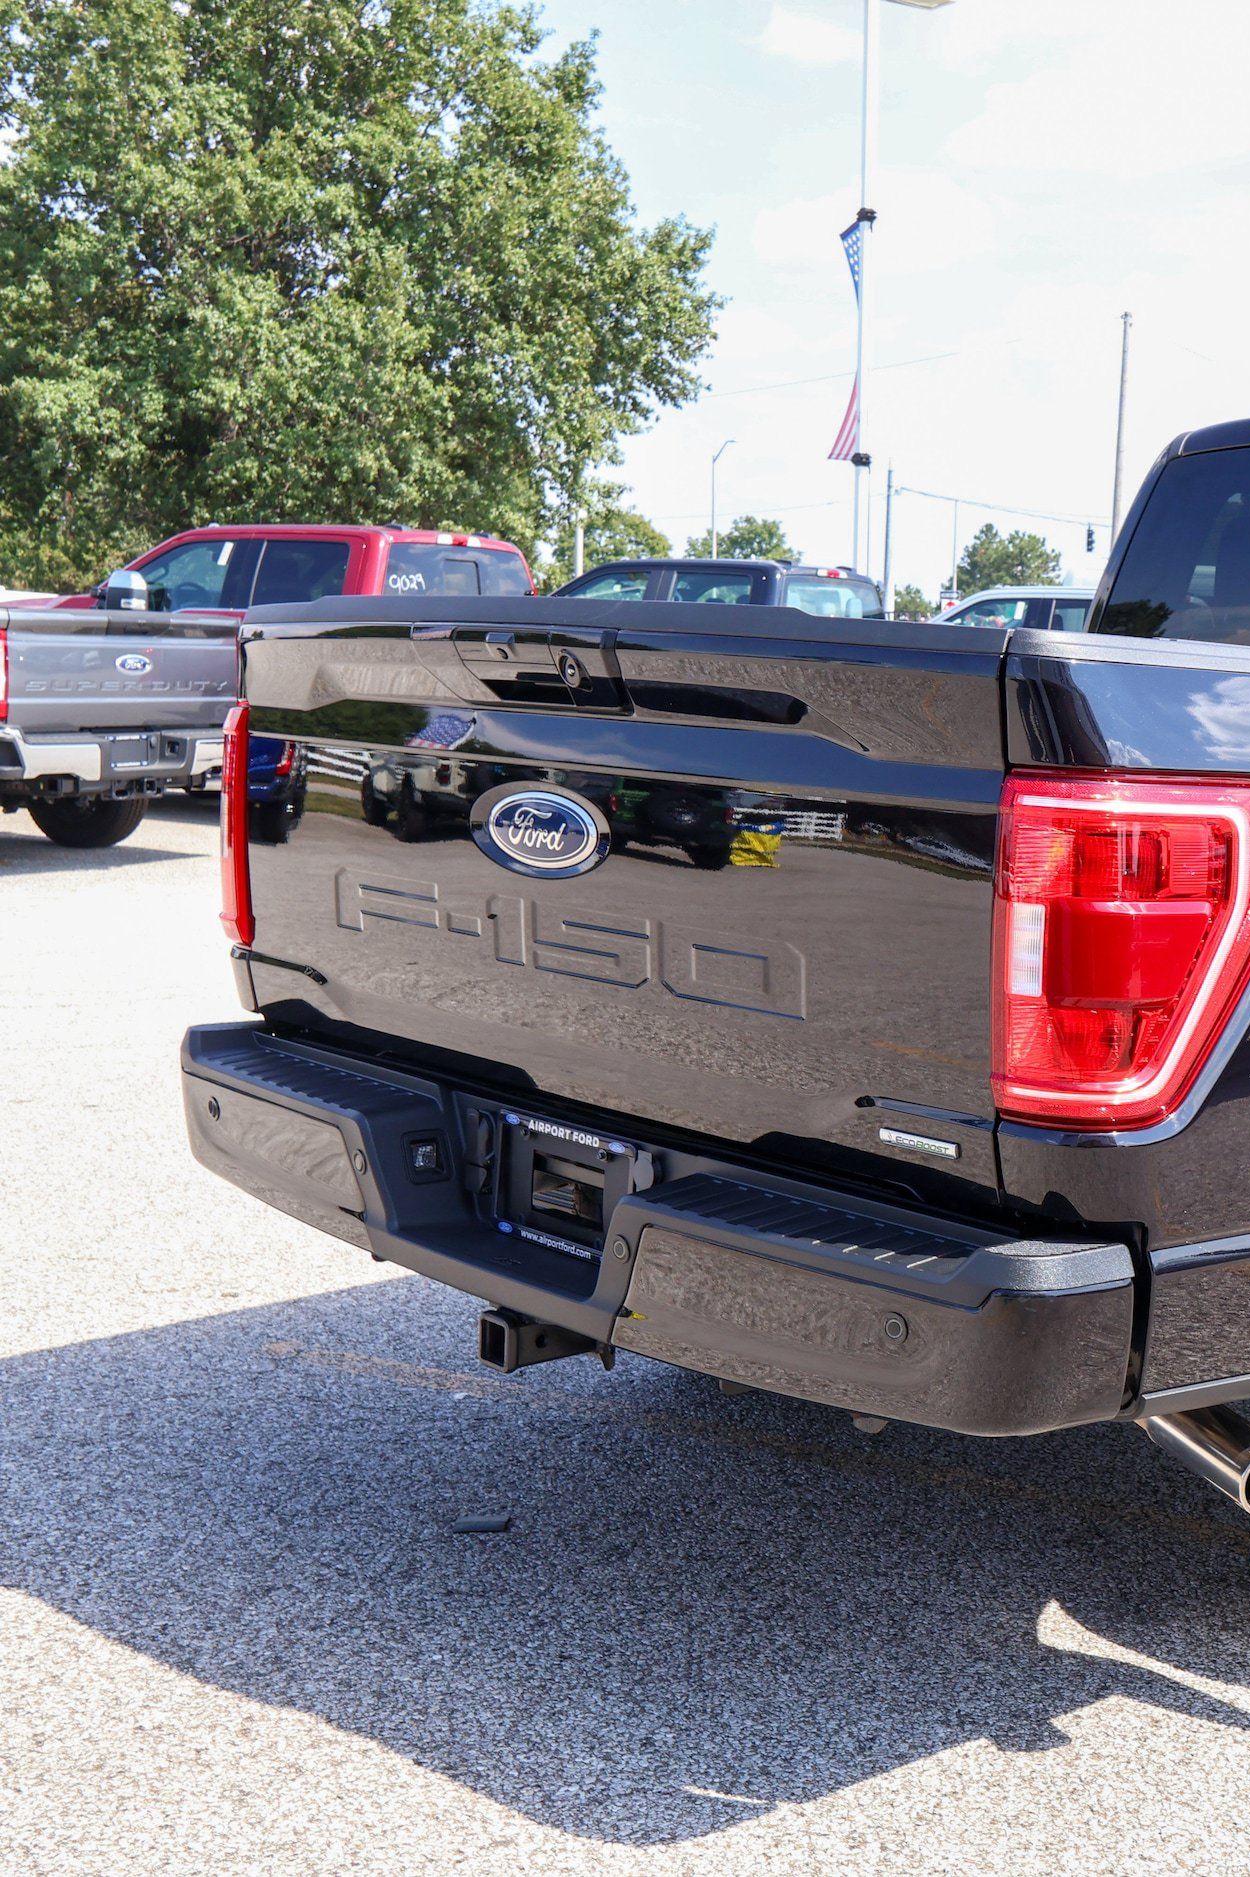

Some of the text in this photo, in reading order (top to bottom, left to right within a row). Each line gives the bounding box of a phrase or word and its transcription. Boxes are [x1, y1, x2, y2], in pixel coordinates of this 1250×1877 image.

[25, 680, 229, 692] SUPER DUTY
[508, 807, 566, 851] Ford
[334, 867, 806, 1021] F-150
[528, 1119, 572, 1140] AIRPORT
[572, 1131, 600, 1147] FORD
[520, 1229, 592, 1260] www.airportford.com
